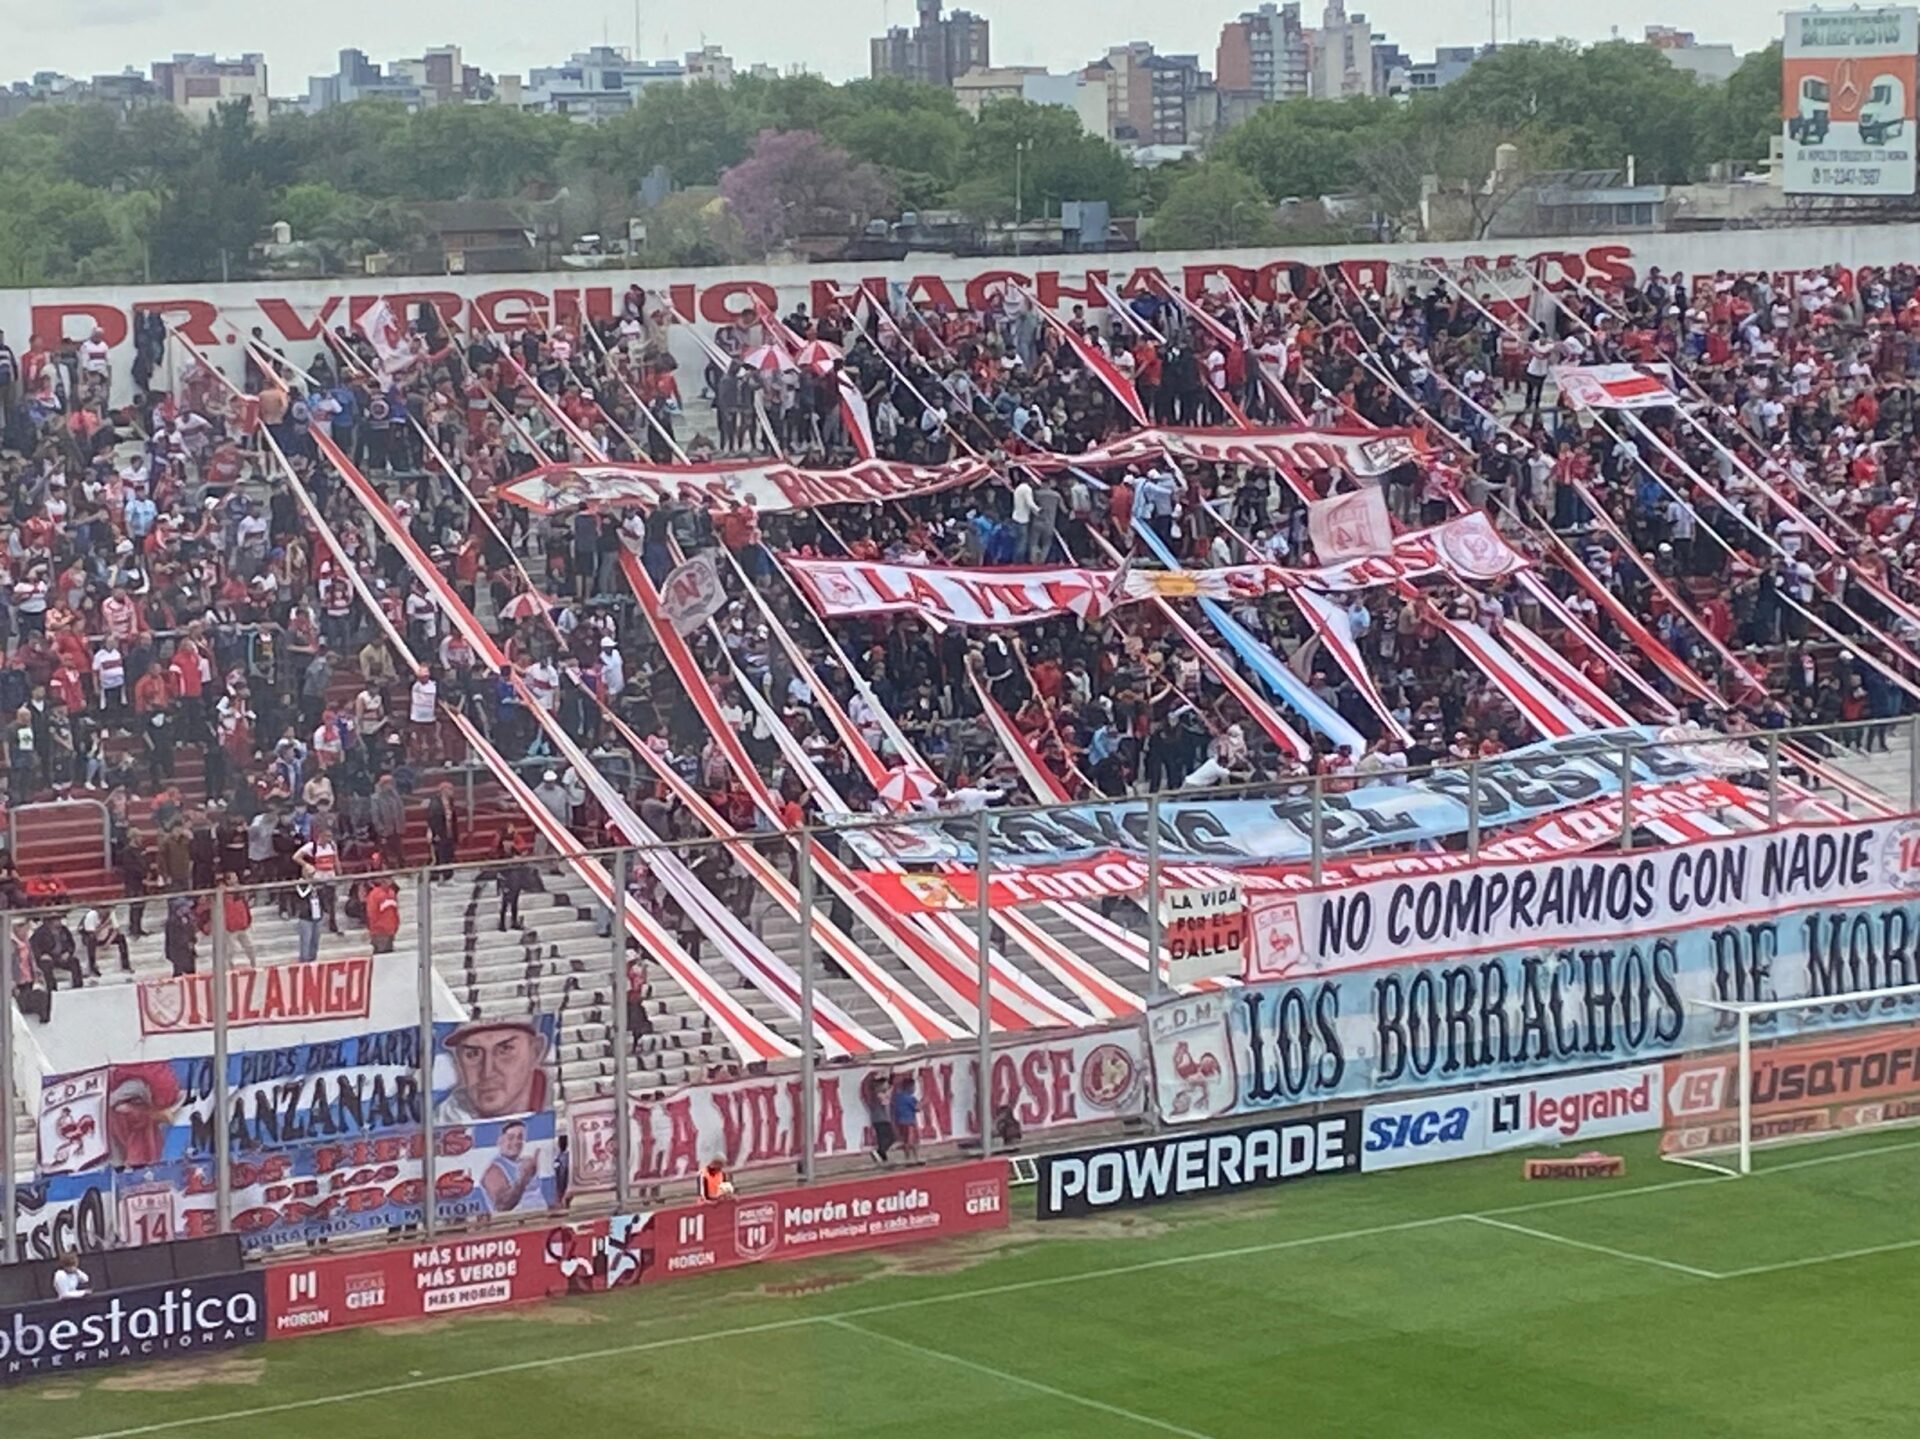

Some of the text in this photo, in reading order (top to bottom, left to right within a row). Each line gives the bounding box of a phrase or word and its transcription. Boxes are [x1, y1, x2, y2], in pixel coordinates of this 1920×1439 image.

[857, 568, 954, 614] LA
[1171, 895, 1192, 910] LA
[1201, 887, 1237, 908] VIDA
[1319, 829, 1874, 957] NO COMPRAMOS CON NADIE
[1171, 930, 1240, 961] GALLO
[1245, 980, 1345, 1102] LOS
[1374, 937, 1681, 1082] BORRACHOS
[1803, 906, 1920, 1016] MOR
[1528, 1082, 1650, 1136] legrand
[633, 1096, 699, 1181] LA
[1049, 1119, 1349, 1212] POWERADE
[136, 1212, 169, 1244] 14
[784, 1201, 848, 1228] Morón
[852, 1198, 872, 1217] te
[876, 1189, 930, 1213] cuida
[413, 1247, 452, 1269] MÁS
[417, 1258, 517, 1289] MÁS VERDE
